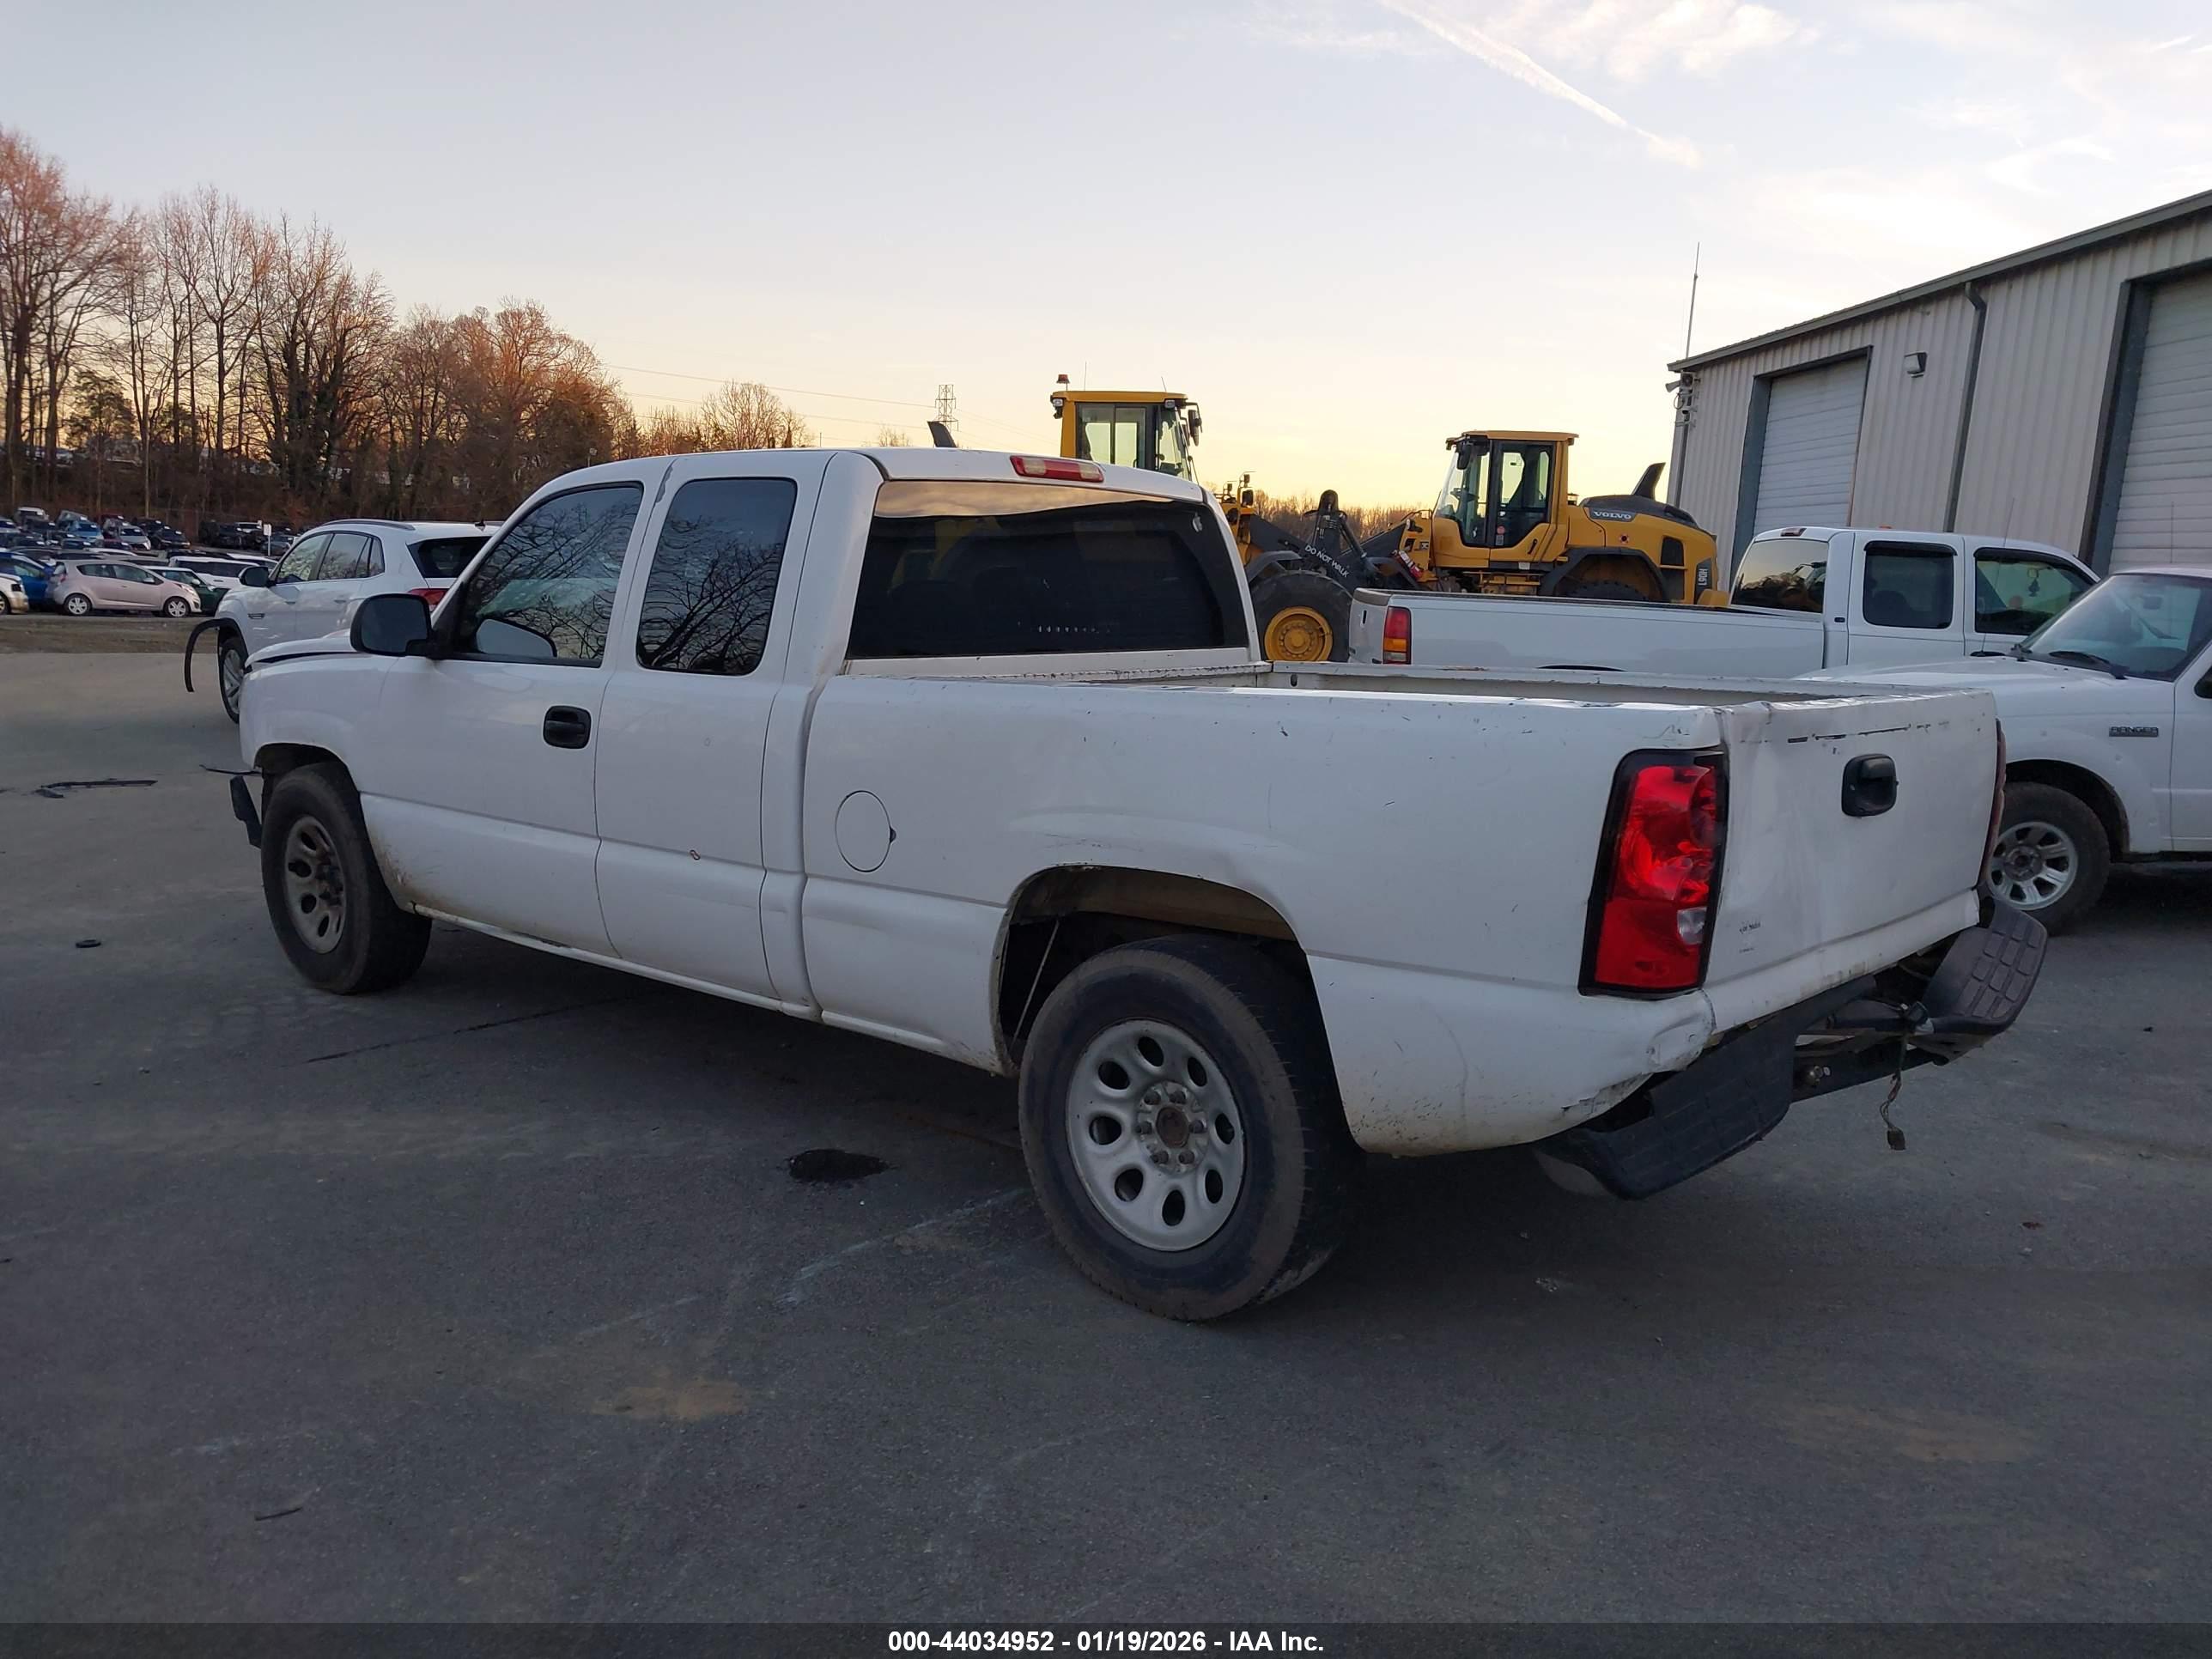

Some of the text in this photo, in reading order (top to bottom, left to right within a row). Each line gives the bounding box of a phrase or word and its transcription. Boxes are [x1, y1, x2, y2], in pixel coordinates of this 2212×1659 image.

[1593, 511, 1632, 520] VOLVO
[1304, 544, 1349, 578] DO NOT WALK
